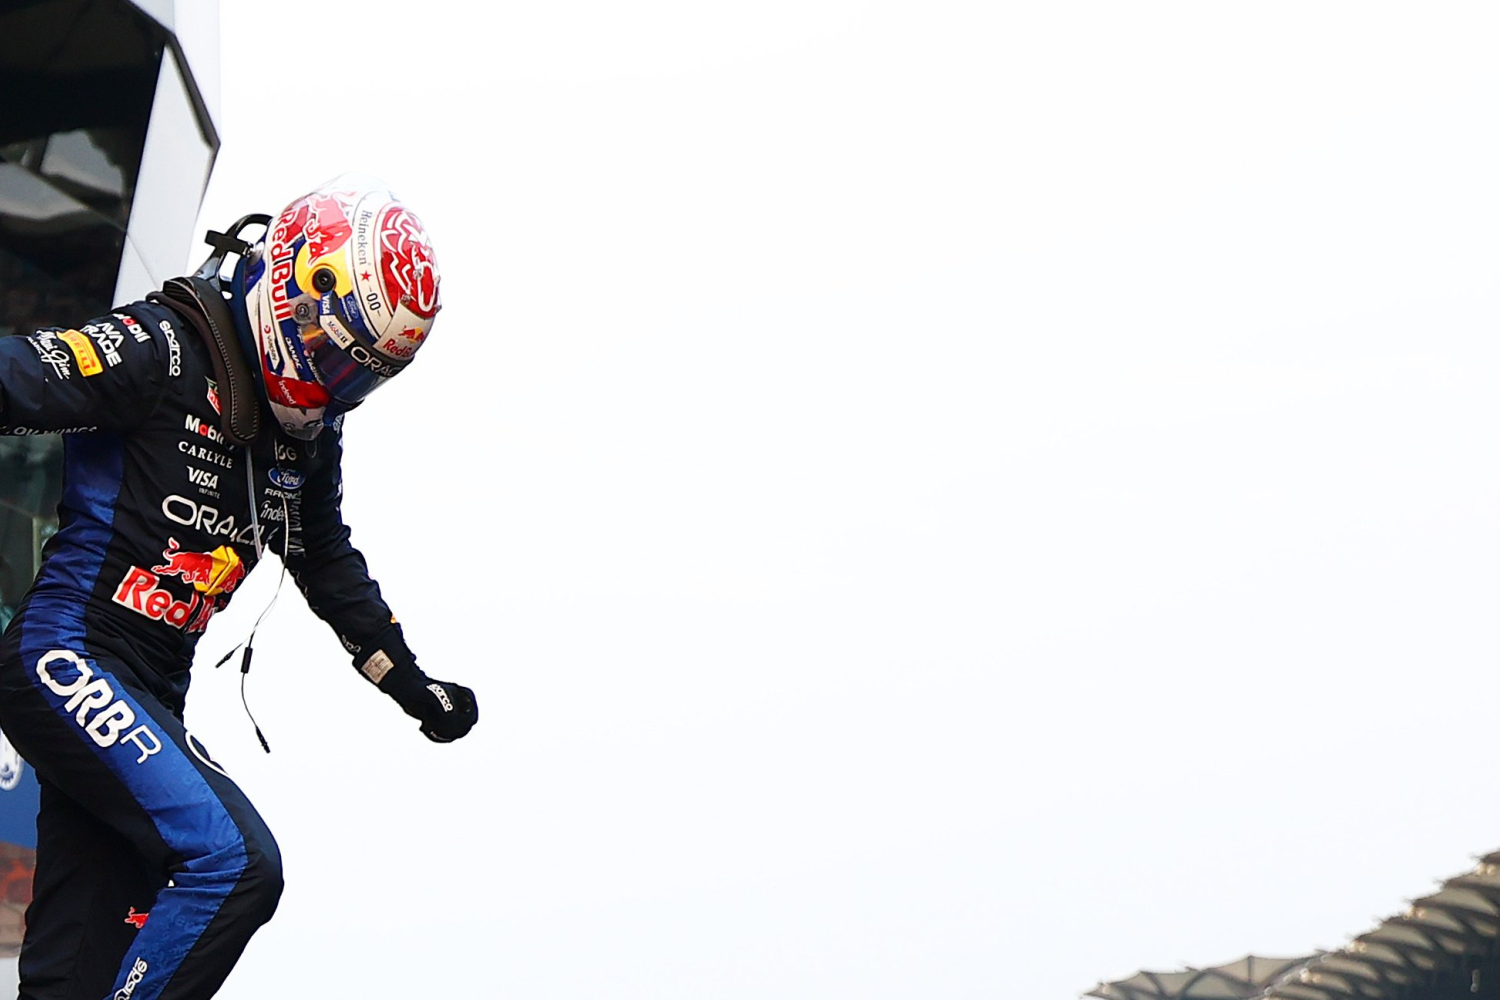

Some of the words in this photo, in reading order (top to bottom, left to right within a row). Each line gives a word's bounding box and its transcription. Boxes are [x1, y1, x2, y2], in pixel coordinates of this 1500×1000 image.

[357, 209, 373, 266] Heineken
[321, 294, 332, 315] VISA
[159, 320, 182, 377] sparco
[278, 379, 297, 405] indeed
[178, 441, 233, 470] CARLYLE
[186, 465, 219, 489] VISA
